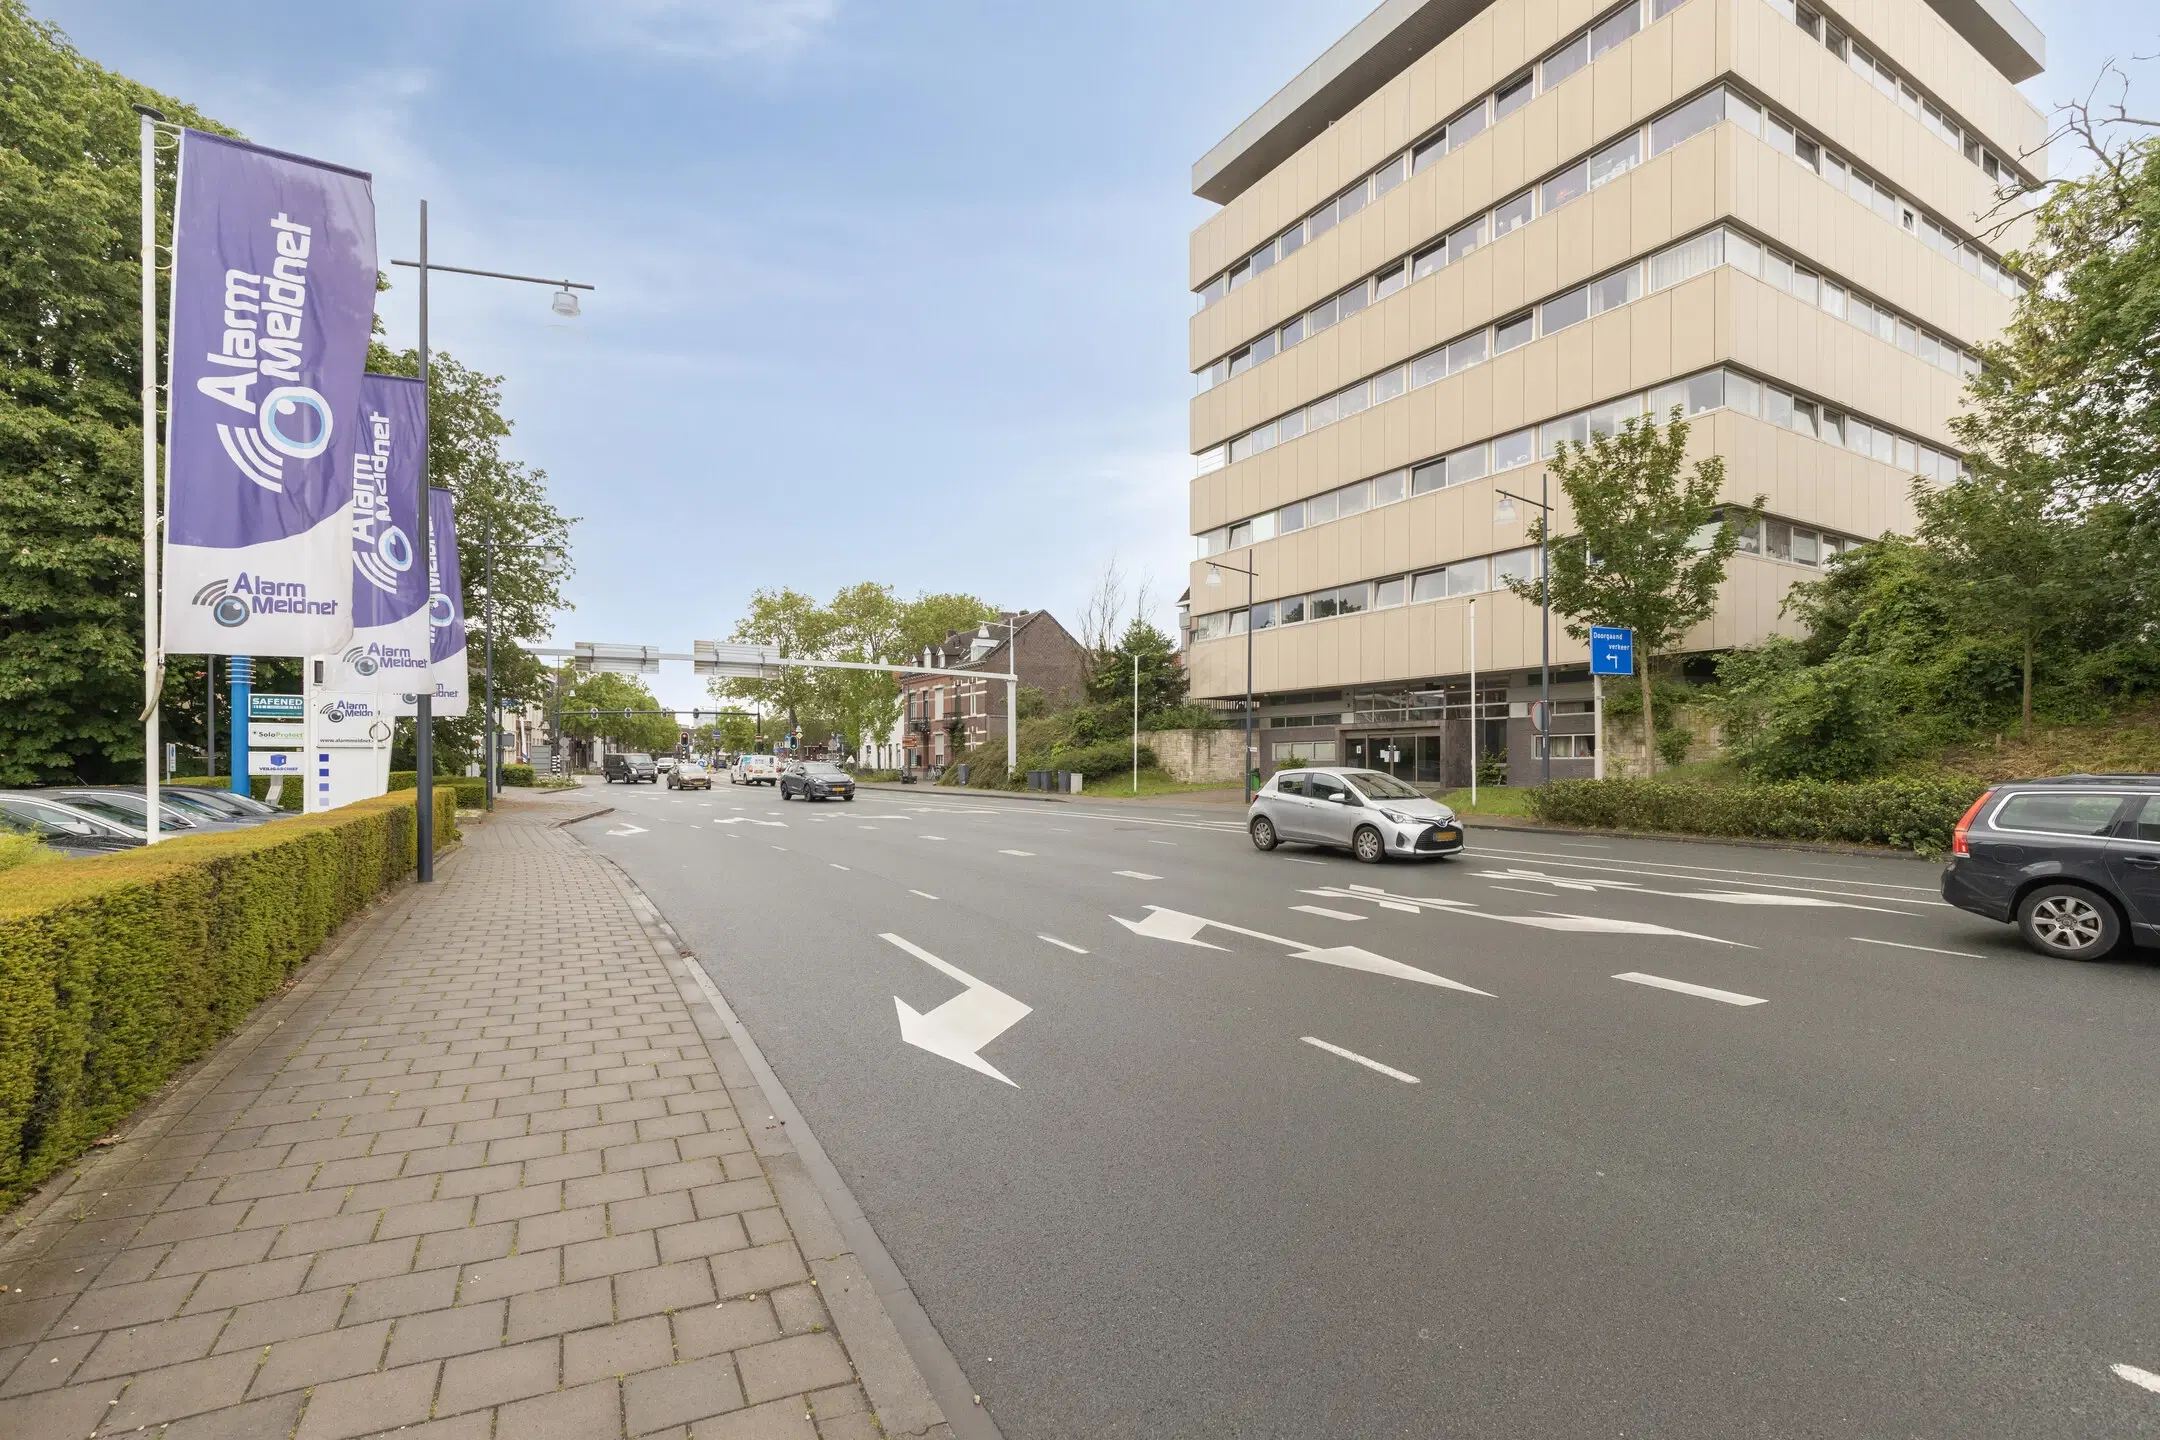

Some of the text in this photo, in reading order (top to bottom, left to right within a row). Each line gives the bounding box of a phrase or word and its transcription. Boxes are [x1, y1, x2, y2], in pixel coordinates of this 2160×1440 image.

[259, 212, 311, 382] Meldnet
[197, 268, 261, 415] Alarm
[352, 453, 375, 545] Alarm
[232, 571, 306, 598] Alarm
[252, 596, 339, 616] Meldnet
[1593, 631, 1623, 641] Doorgaand
[367, 642, 411, 658] Alarm
[379, 658, 428, 669] Meldnet
[252, 697, 303, 706] SAFENED
[337, 700, 368, 710] Alarm
[344, 709, 373, 717] Meldn
